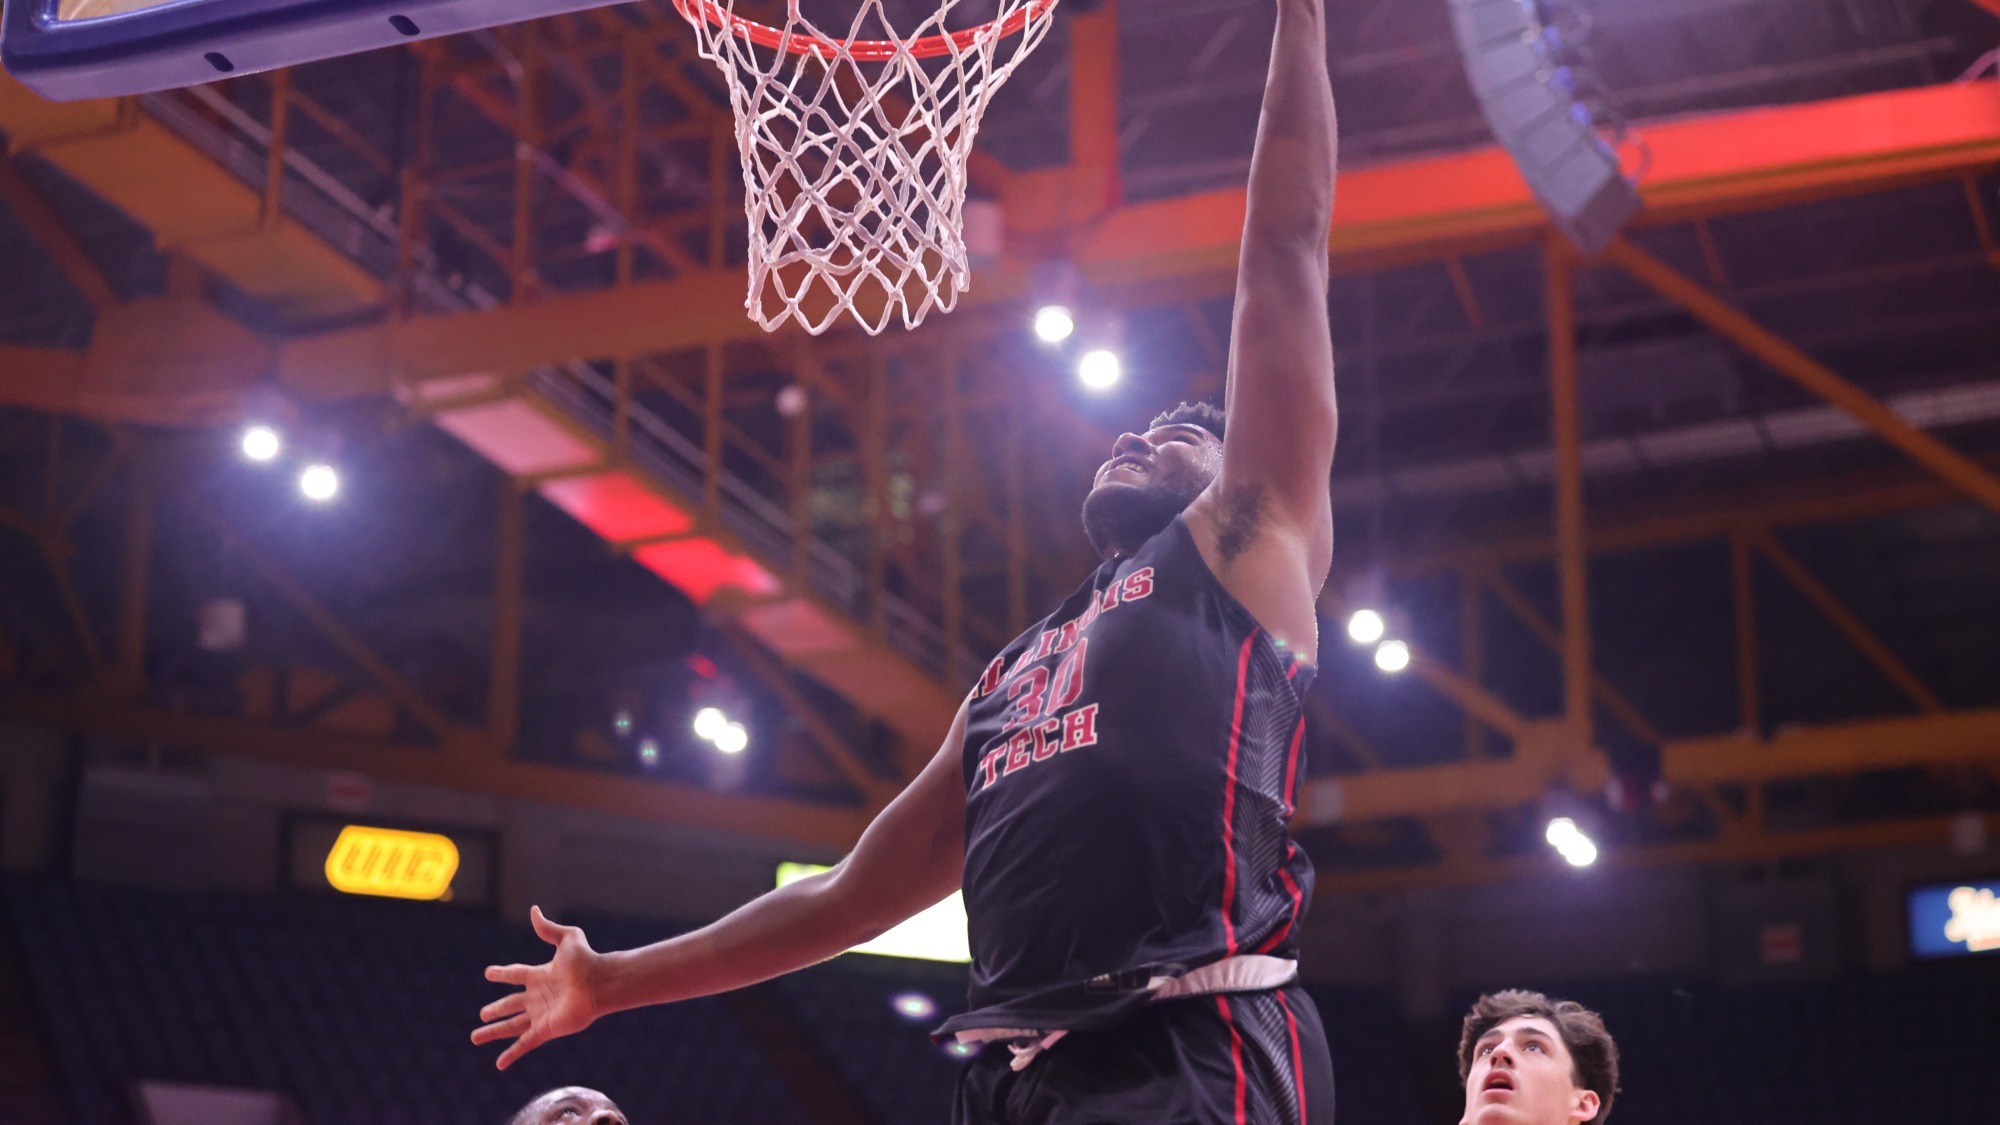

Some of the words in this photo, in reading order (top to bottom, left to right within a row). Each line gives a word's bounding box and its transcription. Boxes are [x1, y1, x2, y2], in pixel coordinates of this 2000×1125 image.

[971, 566, 1155, 699] LLINOIS
[1002, 637, 1088, 733] 30
[980, 702, 1099, 790] TECH
